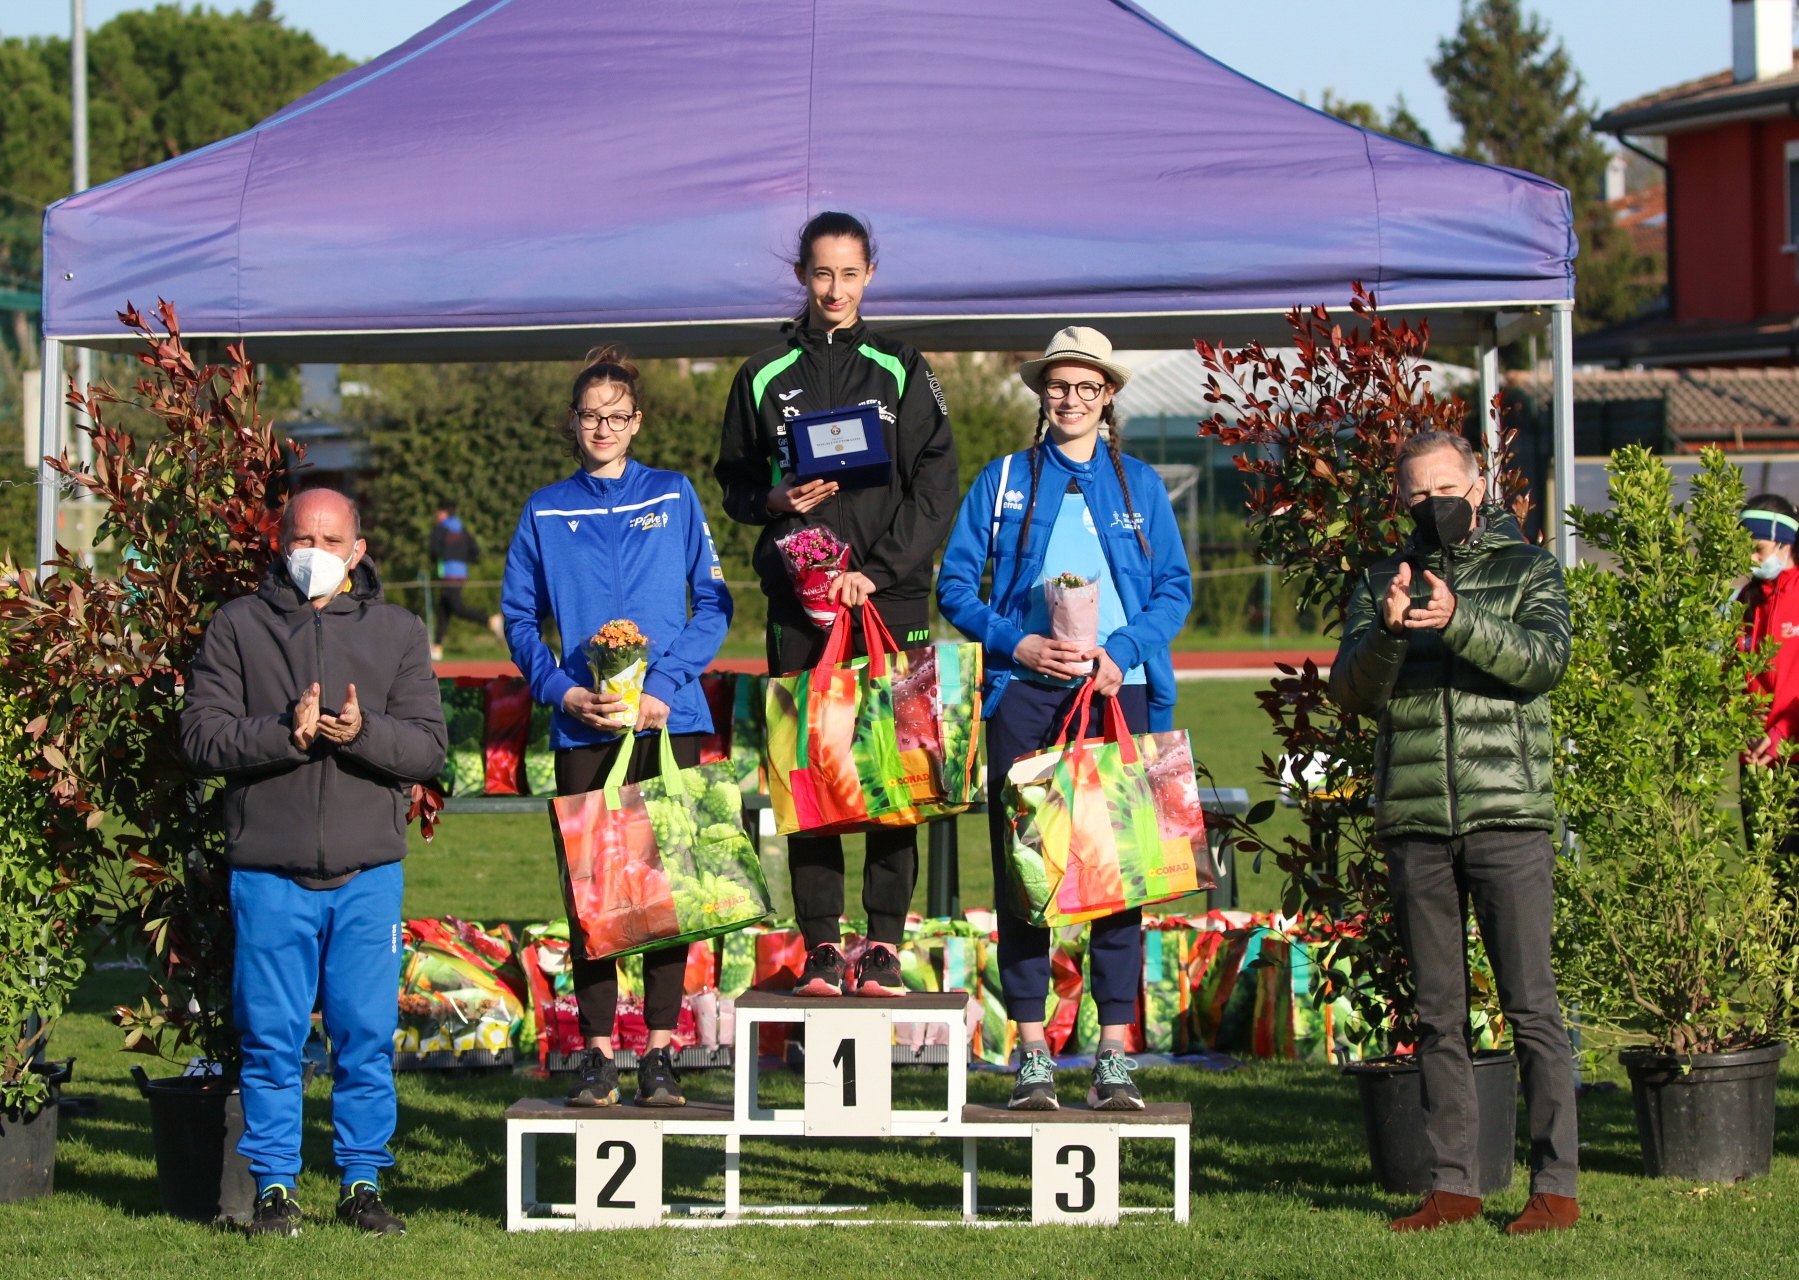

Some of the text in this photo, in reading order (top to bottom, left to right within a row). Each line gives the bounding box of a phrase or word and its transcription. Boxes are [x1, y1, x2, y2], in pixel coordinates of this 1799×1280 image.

[896, 773, 930, 785] CONAD
[1156, 863, 1189, 876] CONAD
[713, 895, 746, 911] CONAD
[833, 1039, 857, 1107] 1
[597, 1141, 637, 1209] 2
[1056, 1145, 1096, 1213] 3
